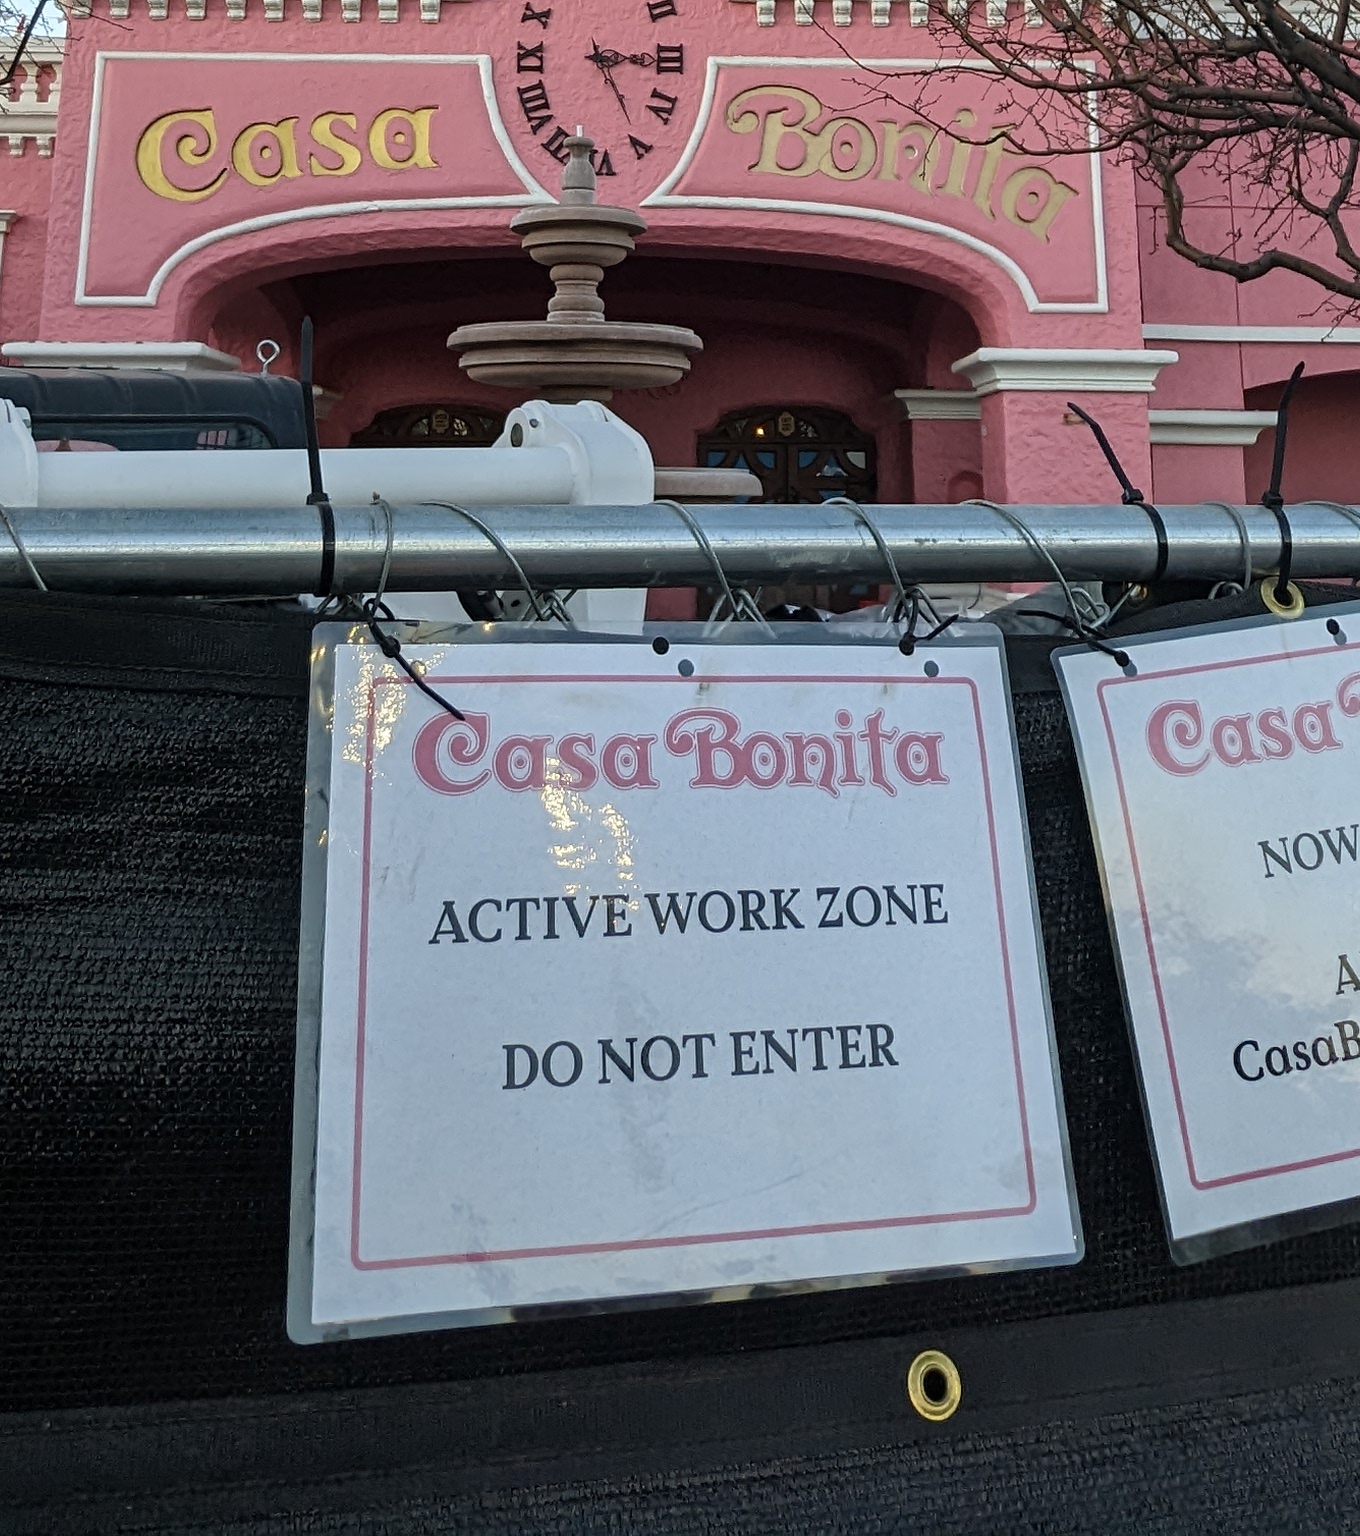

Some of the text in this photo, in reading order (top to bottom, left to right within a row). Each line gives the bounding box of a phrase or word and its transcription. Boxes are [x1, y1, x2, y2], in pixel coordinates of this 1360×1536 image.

[520, 1, 552, 30] X
[656, 43, 684, 75] III
[135, 83, 1080, 245] Casa Bonita
[412, 706, 950, 798] Casa Bonita
[1144, 699, 1343, 777] Casa
[428, 883, 950, 946] ACTIVE WORK ZONE
[501, 1022, 900, 1091] DO NOT ENTER
